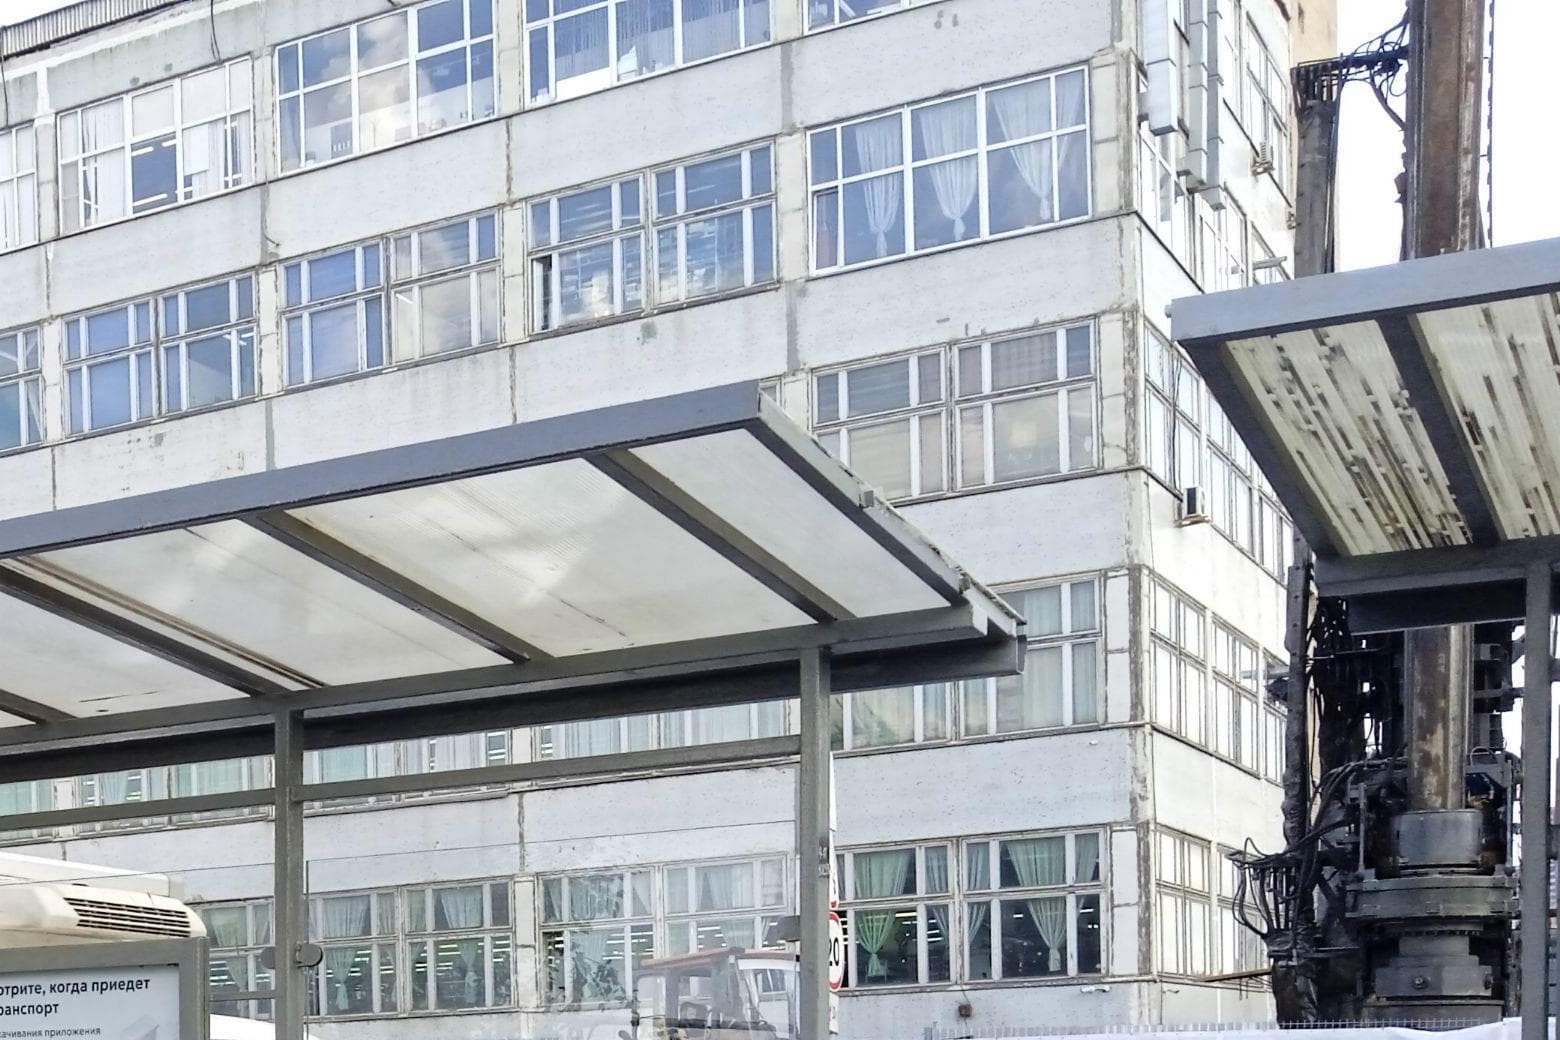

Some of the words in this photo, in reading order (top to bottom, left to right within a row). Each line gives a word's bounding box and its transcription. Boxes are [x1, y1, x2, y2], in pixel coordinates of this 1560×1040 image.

[49, 979, 88, 996] когда
[91, 977, 151, 995] приедет
[45, 1026, 101, 1039] приложения
